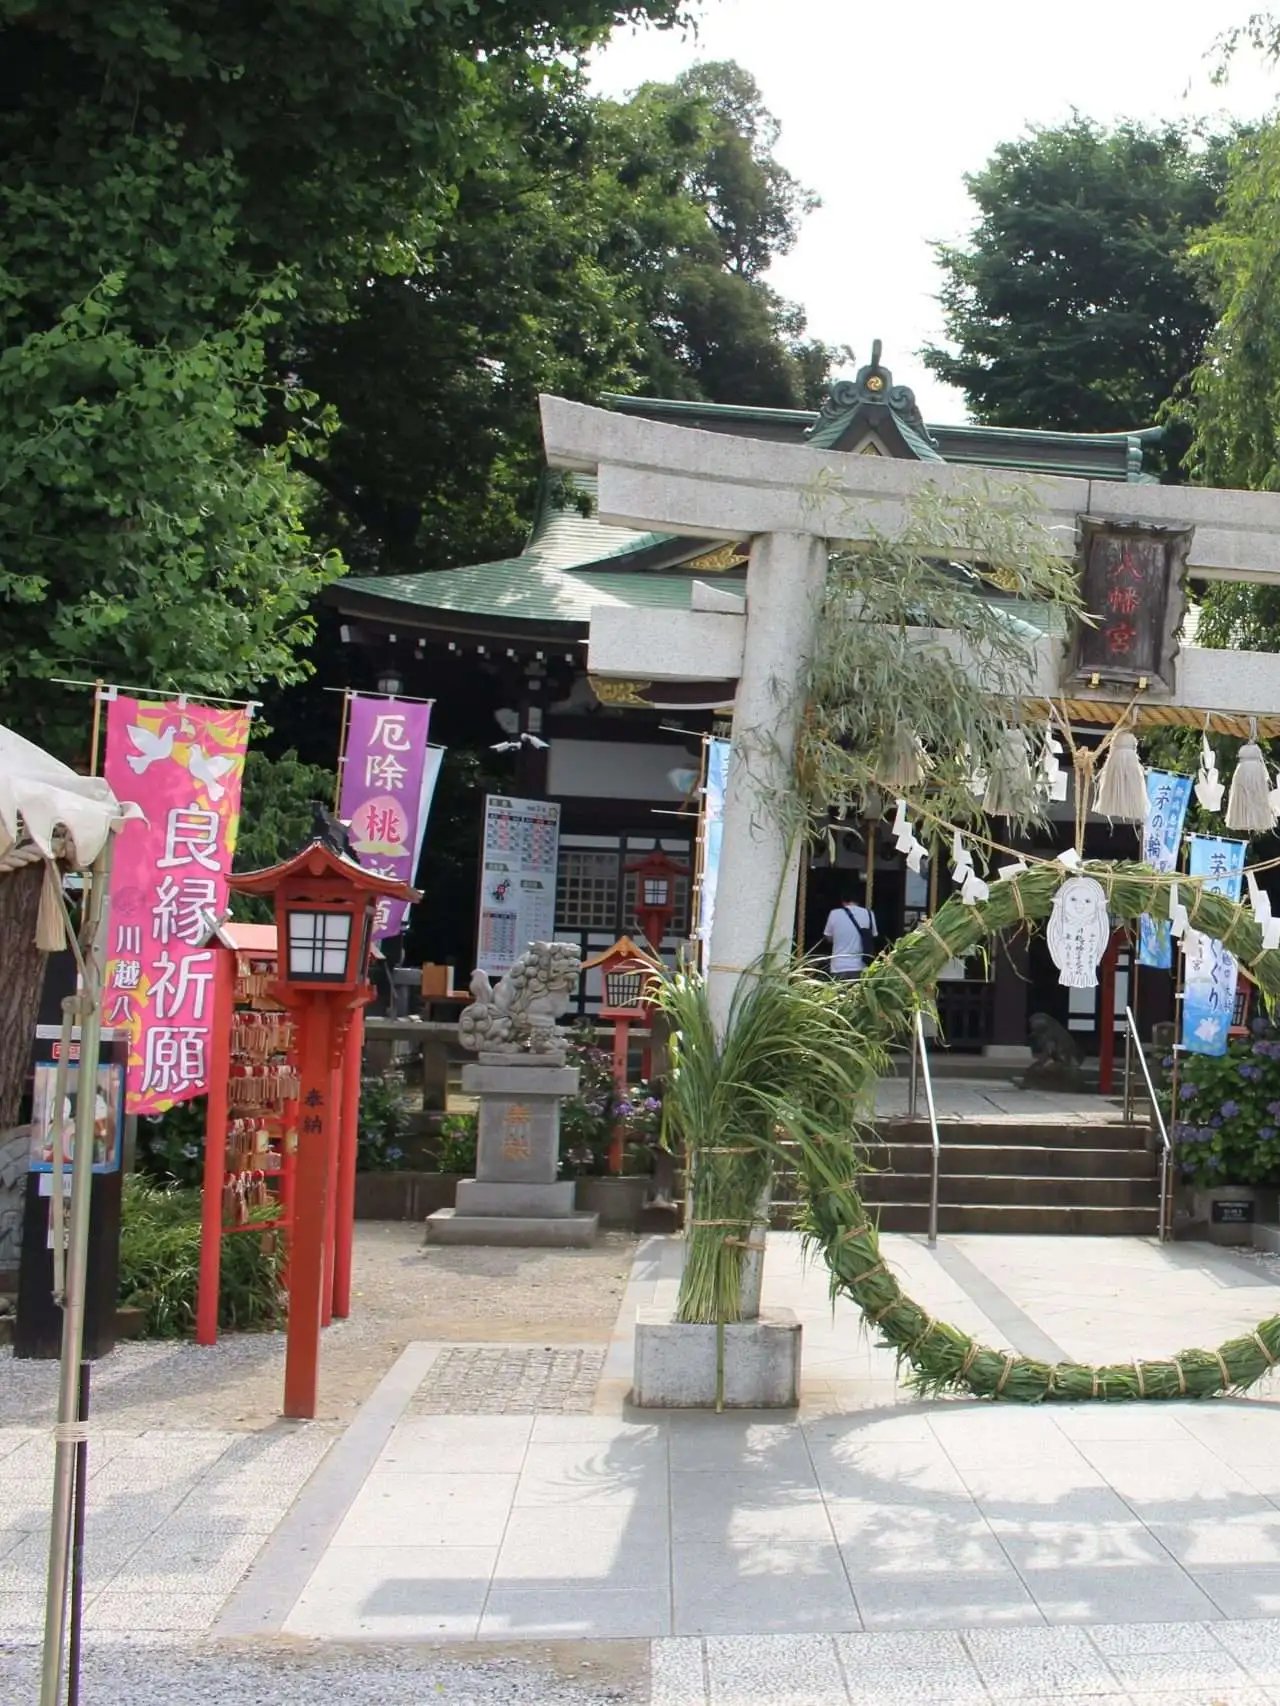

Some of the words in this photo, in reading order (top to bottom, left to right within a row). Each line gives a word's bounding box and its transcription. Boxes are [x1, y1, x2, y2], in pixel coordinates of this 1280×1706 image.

[1106, 549, 1144, 655] 八幡宮
[141, 802, 222, 1094] 良縁祈願
